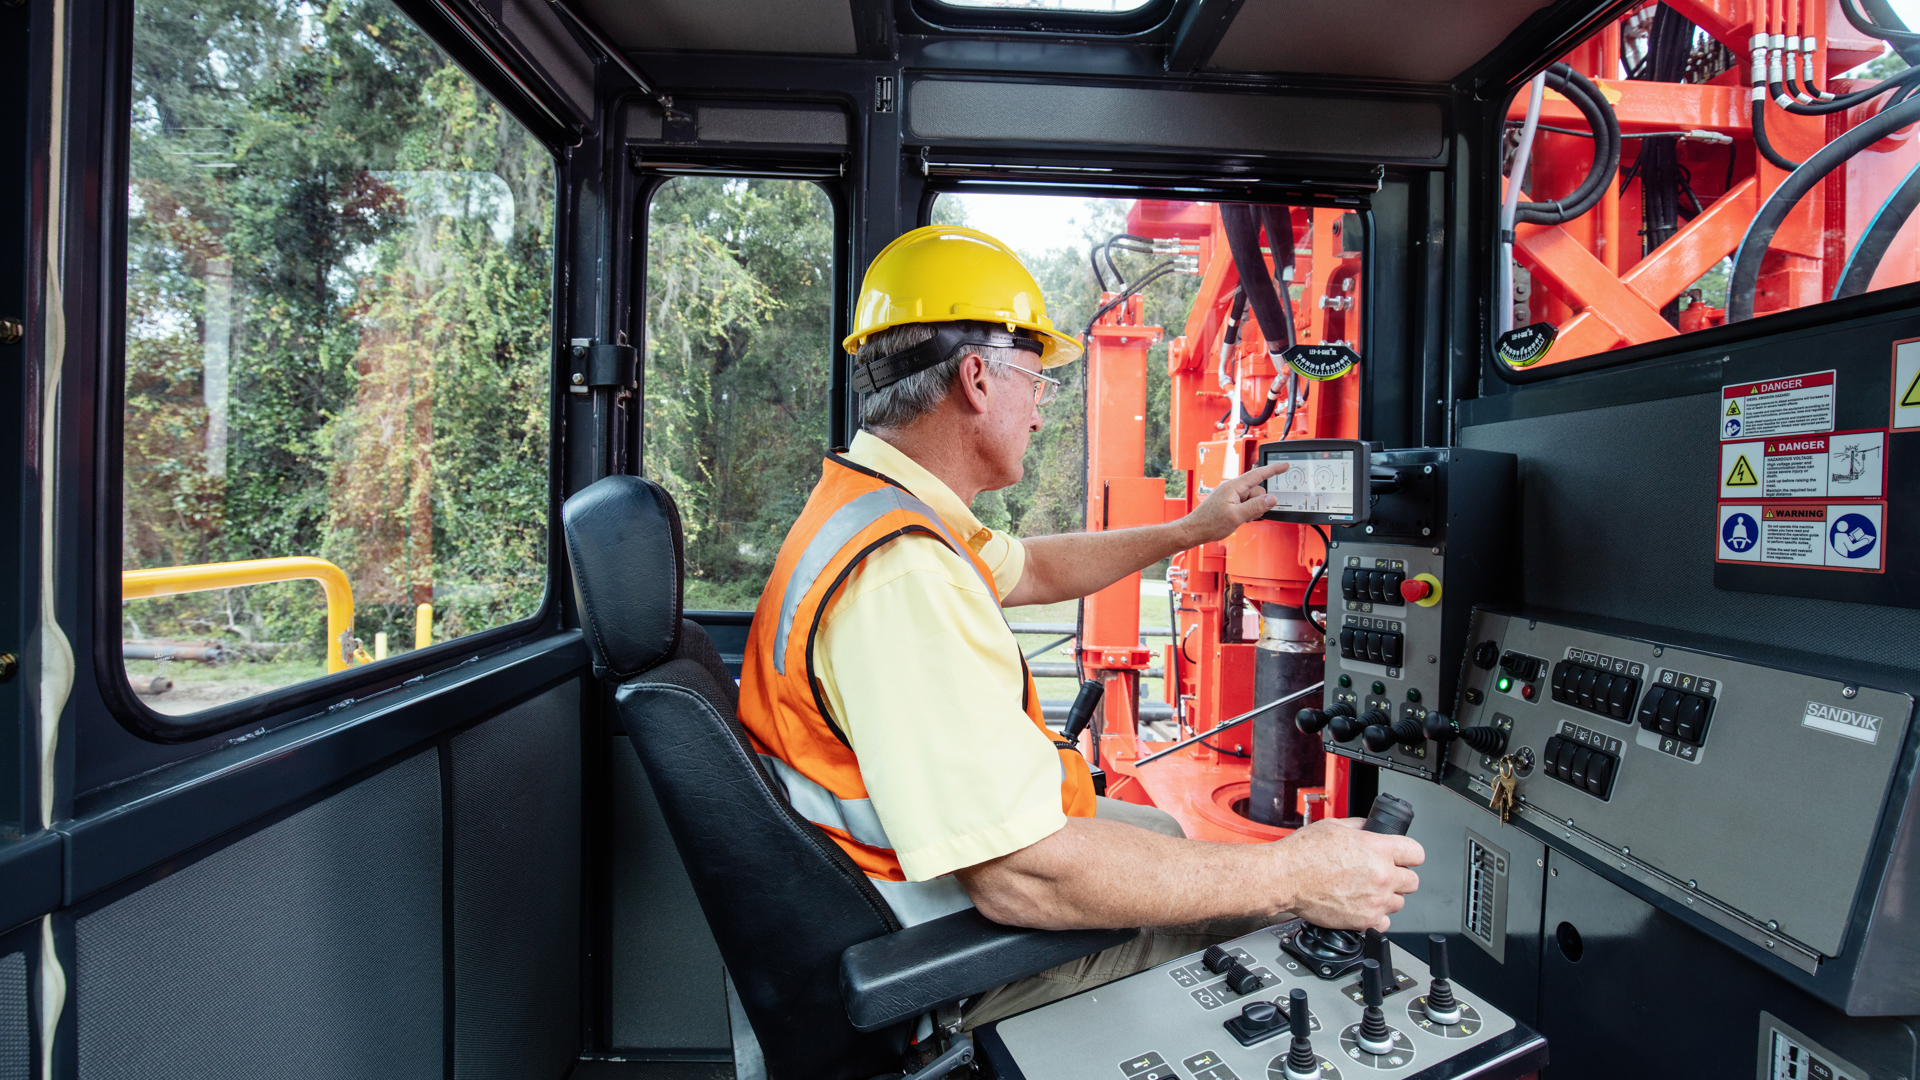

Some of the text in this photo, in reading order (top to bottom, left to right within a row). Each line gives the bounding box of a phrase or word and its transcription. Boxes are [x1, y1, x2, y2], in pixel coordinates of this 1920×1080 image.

[1761, 379, 1802, 392] DANGER
[1779, 440, 1824, 451] DANGER
[1807, 703, 1879, 730] SANDVIK
